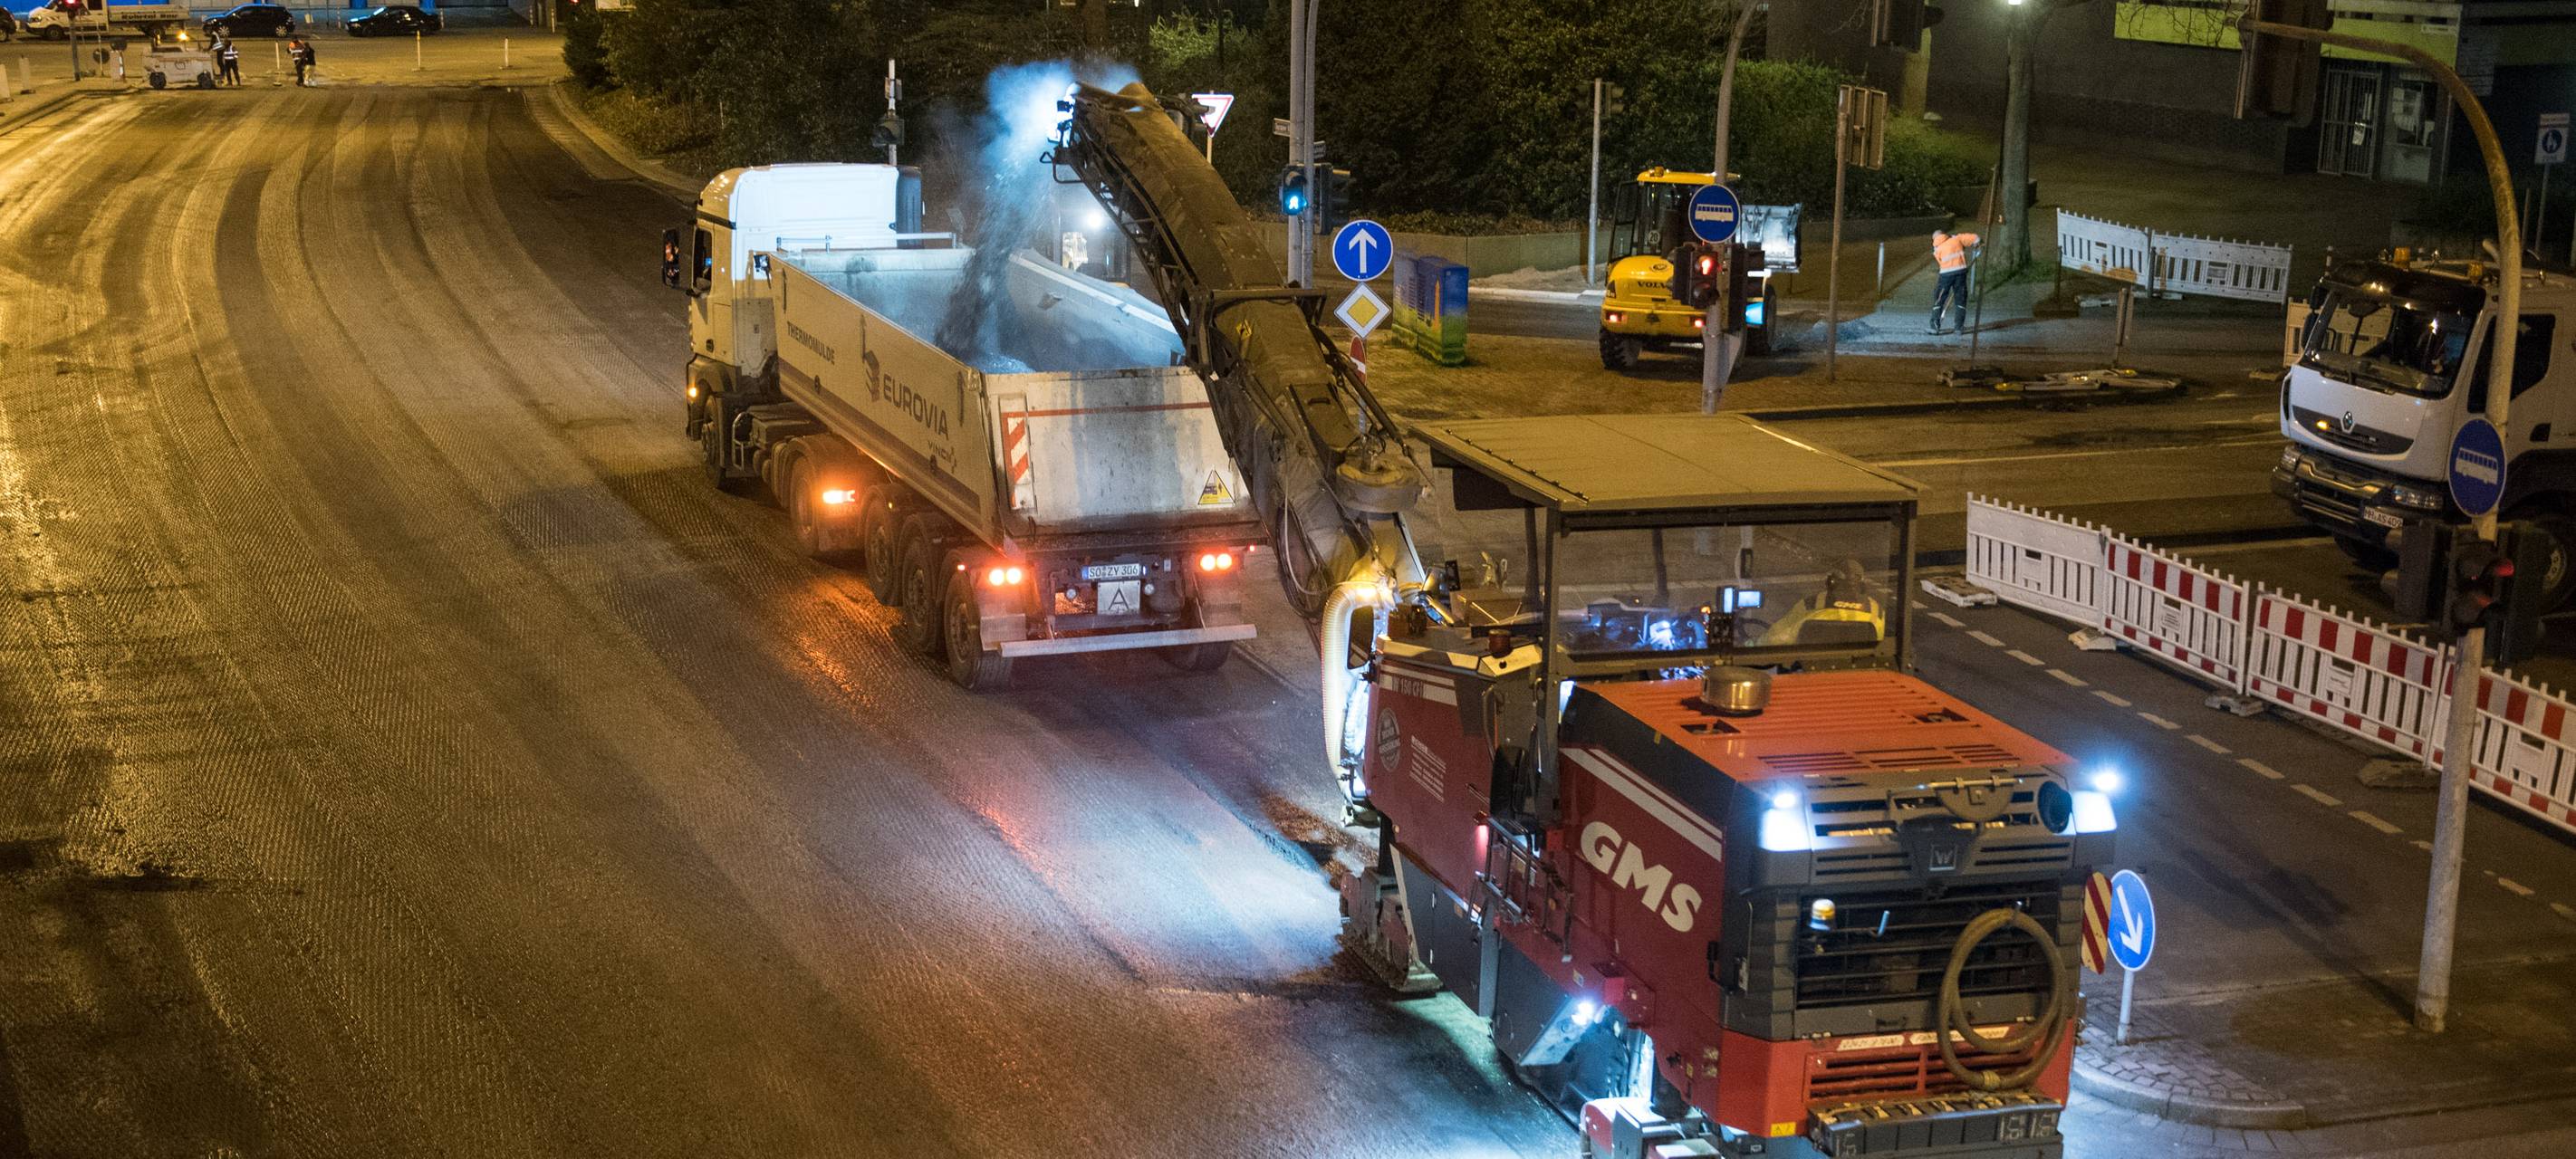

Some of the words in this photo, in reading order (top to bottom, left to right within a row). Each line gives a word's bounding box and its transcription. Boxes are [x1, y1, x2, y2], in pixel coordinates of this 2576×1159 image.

[1650, 232, 1658, 242] 20
[1638, 281, 1668, 289] VOLV
[786, 321, 835, 366] THERMOMULDE
[883, 373, 949, 442] EUROVIA
[1089, 567, 1101, 579] SO
[1107, 566, 1120, 577] ZY
[1122, 565, 1139, 576] 306
[1108, 586, 1129, 610] A
[1581, 820, 1703, 933] GMS
